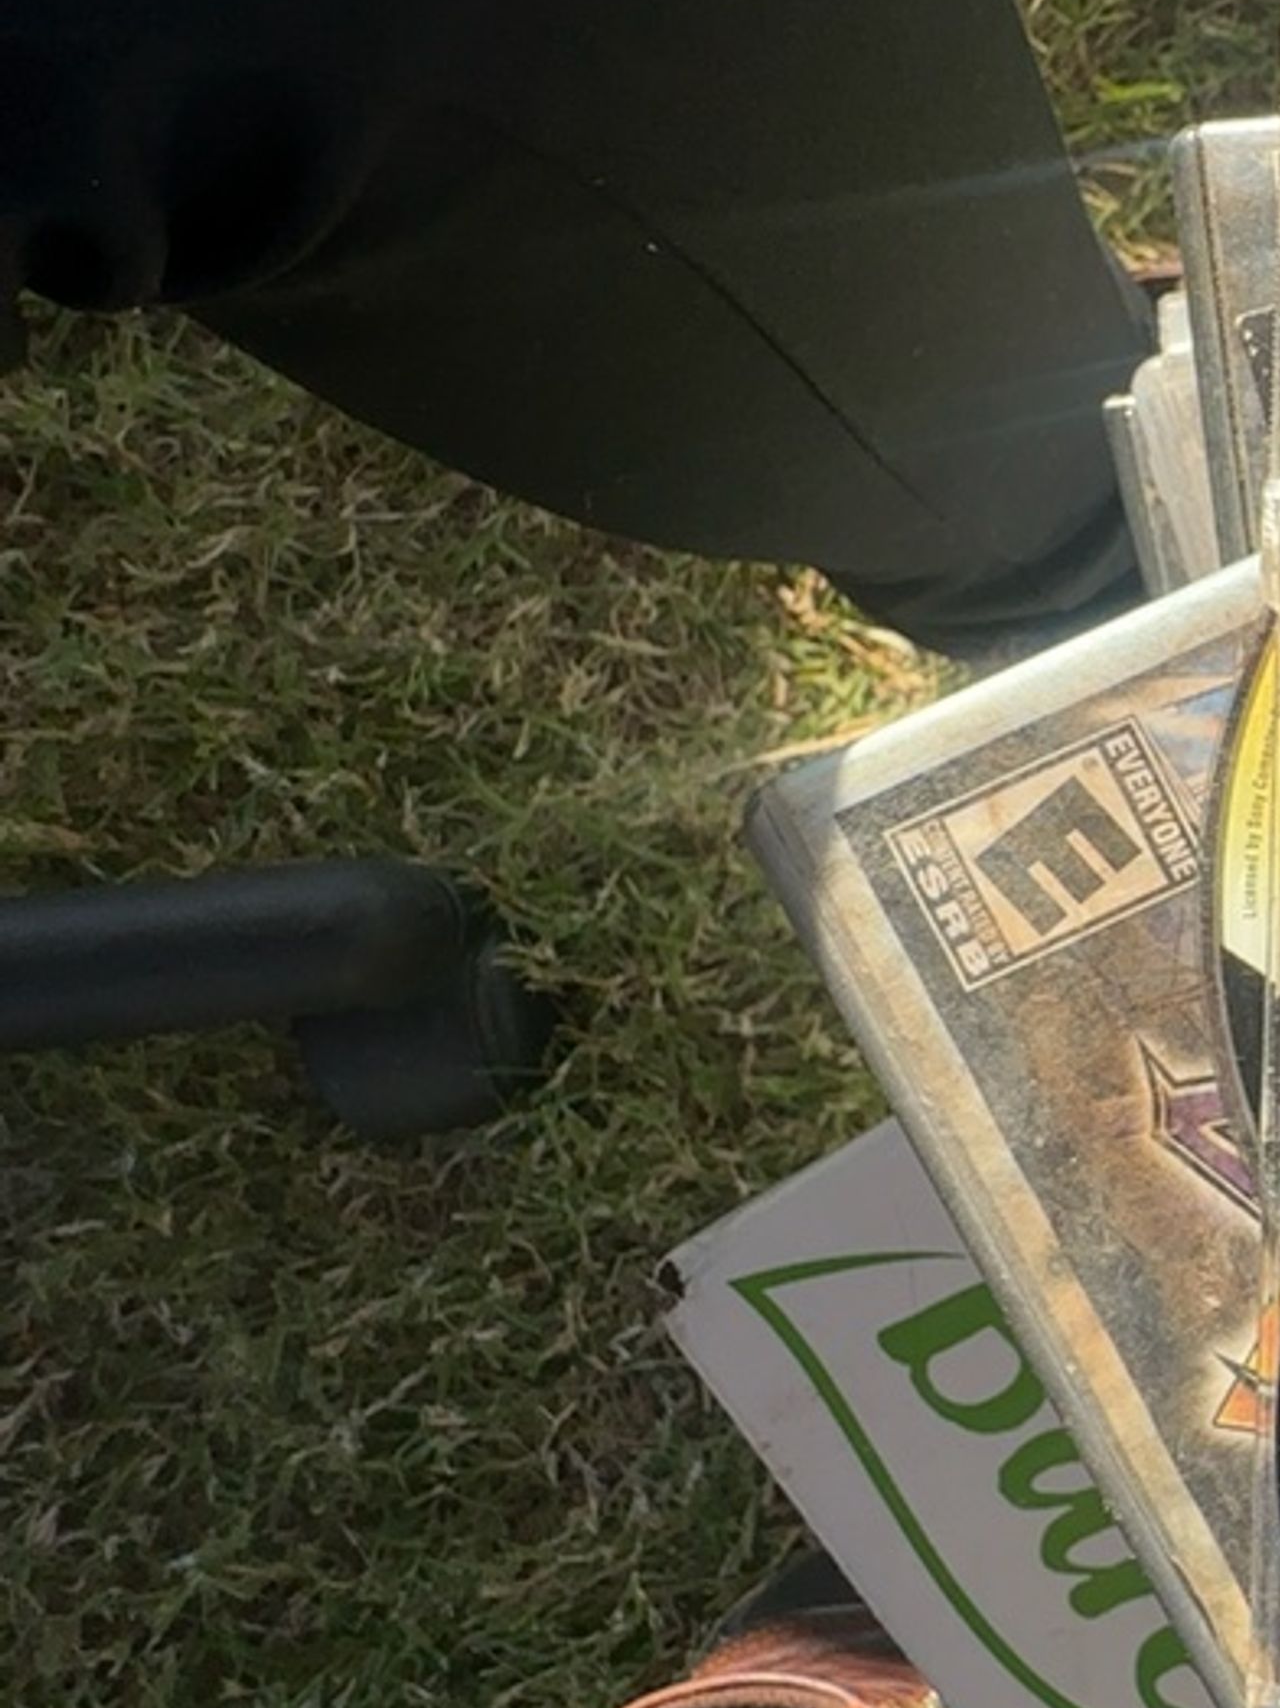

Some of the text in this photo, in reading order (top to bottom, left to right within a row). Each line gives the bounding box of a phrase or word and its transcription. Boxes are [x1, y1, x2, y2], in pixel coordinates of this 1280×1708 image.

[974, 775, 1143, 937] E
[1105, 731, 1198, 882] EVERYONE
[900, 832, 989, 977] ESRB
